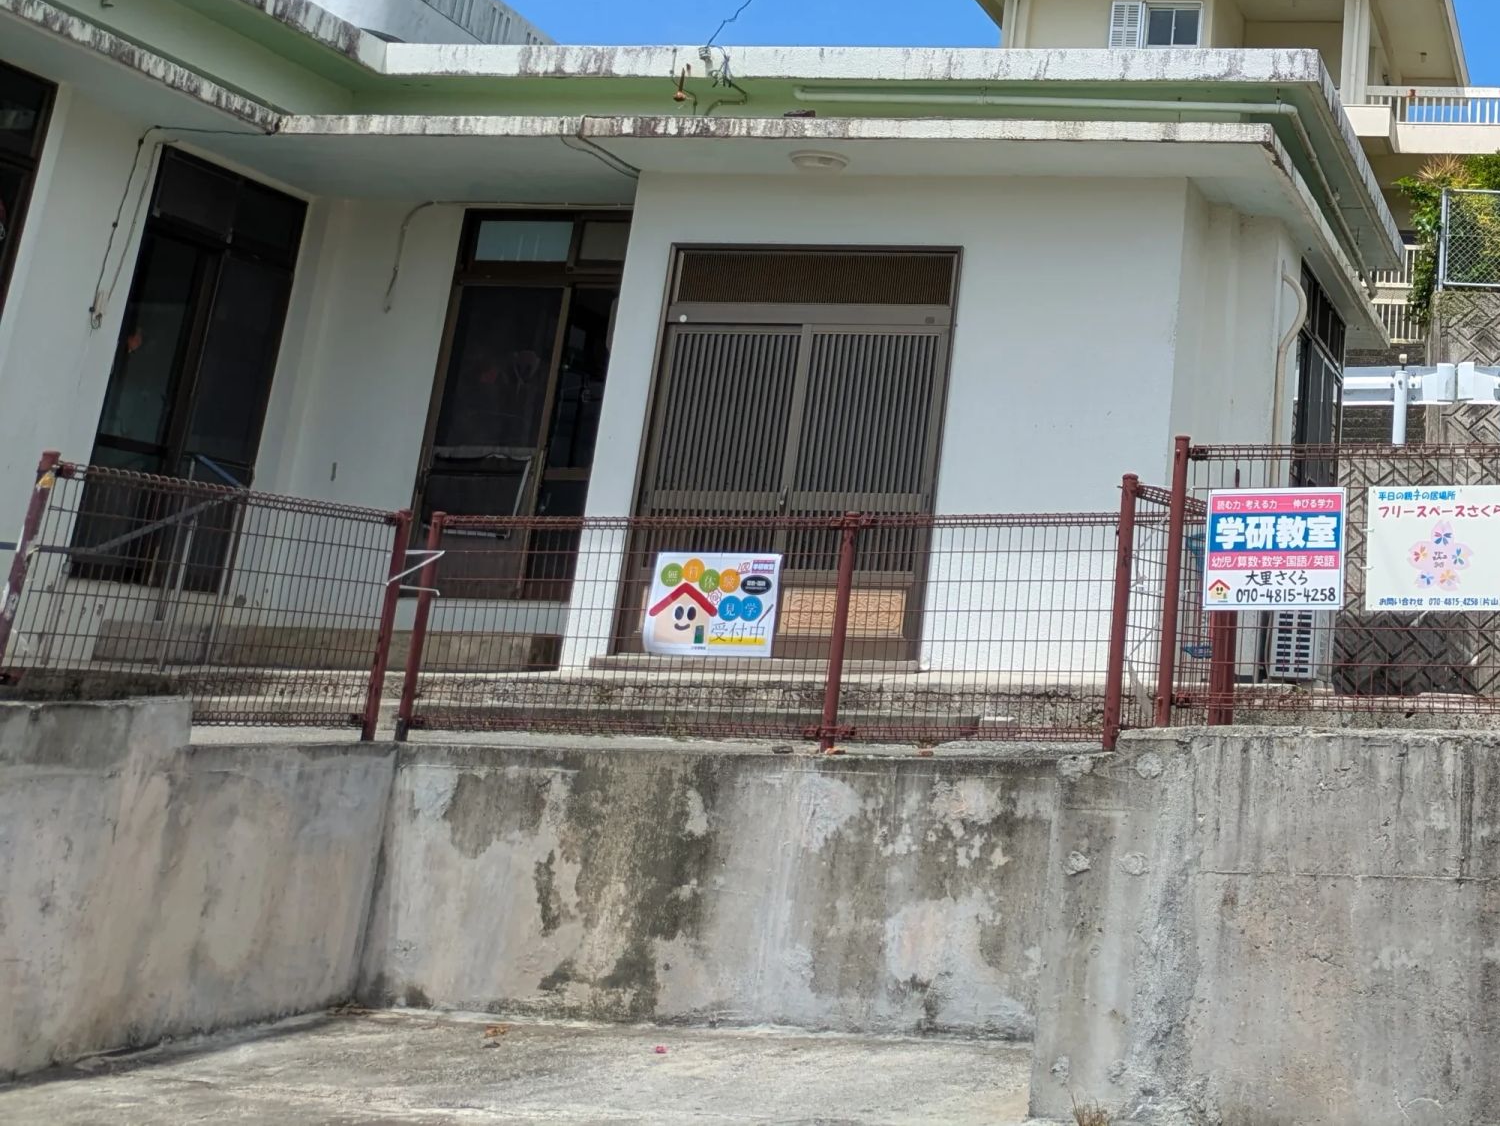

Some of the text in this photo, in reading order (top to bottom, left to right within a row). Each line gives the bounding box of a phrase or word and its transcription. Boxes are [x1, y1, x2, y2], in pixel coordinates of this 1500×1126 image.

[1215, 515, 1338, 550] 学研教室
[1245, 570, 1308, 586] 大里さくら
[1236, 587, 1336, 603] 070-4815-4258
[1379, 597, 1424, 606] お問い合わせ
[726, 602, 758, 617] 見学
[711, 622, 766, 643] 受付中
